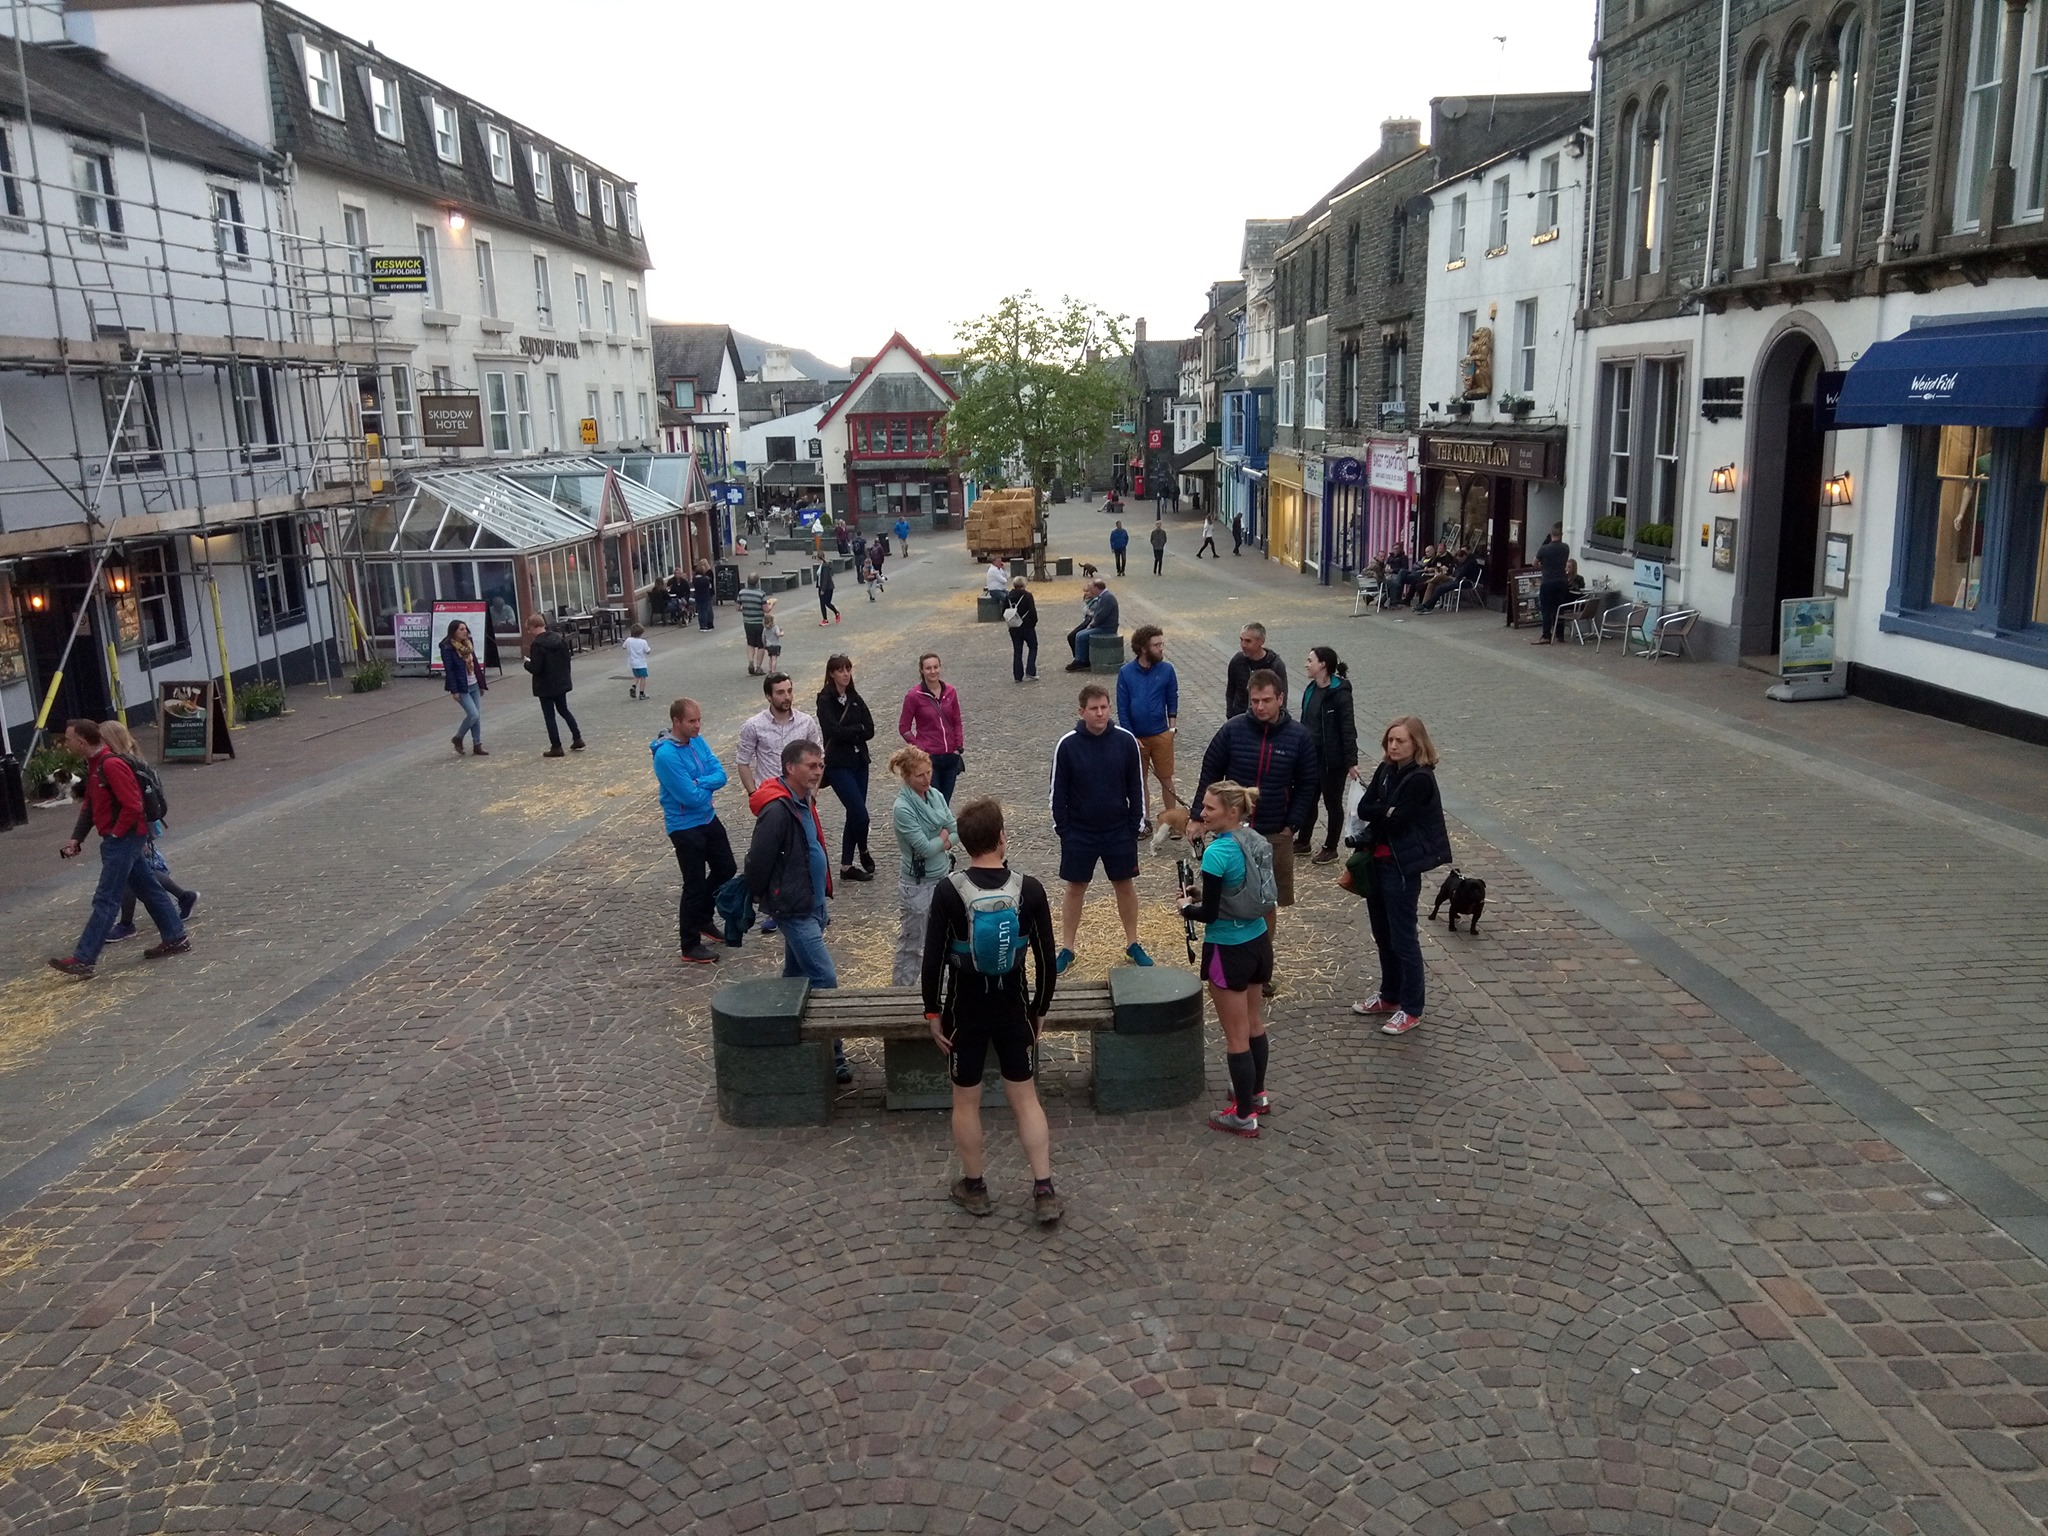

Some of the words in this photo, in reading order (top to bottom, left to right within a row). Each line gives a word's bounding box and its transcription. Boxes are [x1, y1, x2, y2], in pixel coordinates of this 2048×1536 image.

[375, 260, 420, 269] KESWICK
[519, 336, 556, 365] SKIDDAW
[1911, 374, 1939, 391] Weird
[1935, 372, 1959, 391] Fish
[428, 410, 473, 420] SKIDDAW
[435, 420, 469, 429] HOTEL
[582, 423, 594, 431] AA
[1437, 443, 1453, 460] THE
[1453, 444, 1486, 464] GOLDEN
[1487, 446, 1511, 466] LION
[399, 630, 429, 638] MADNESS
[998, 920, 1011, 971] ULTIMATE
